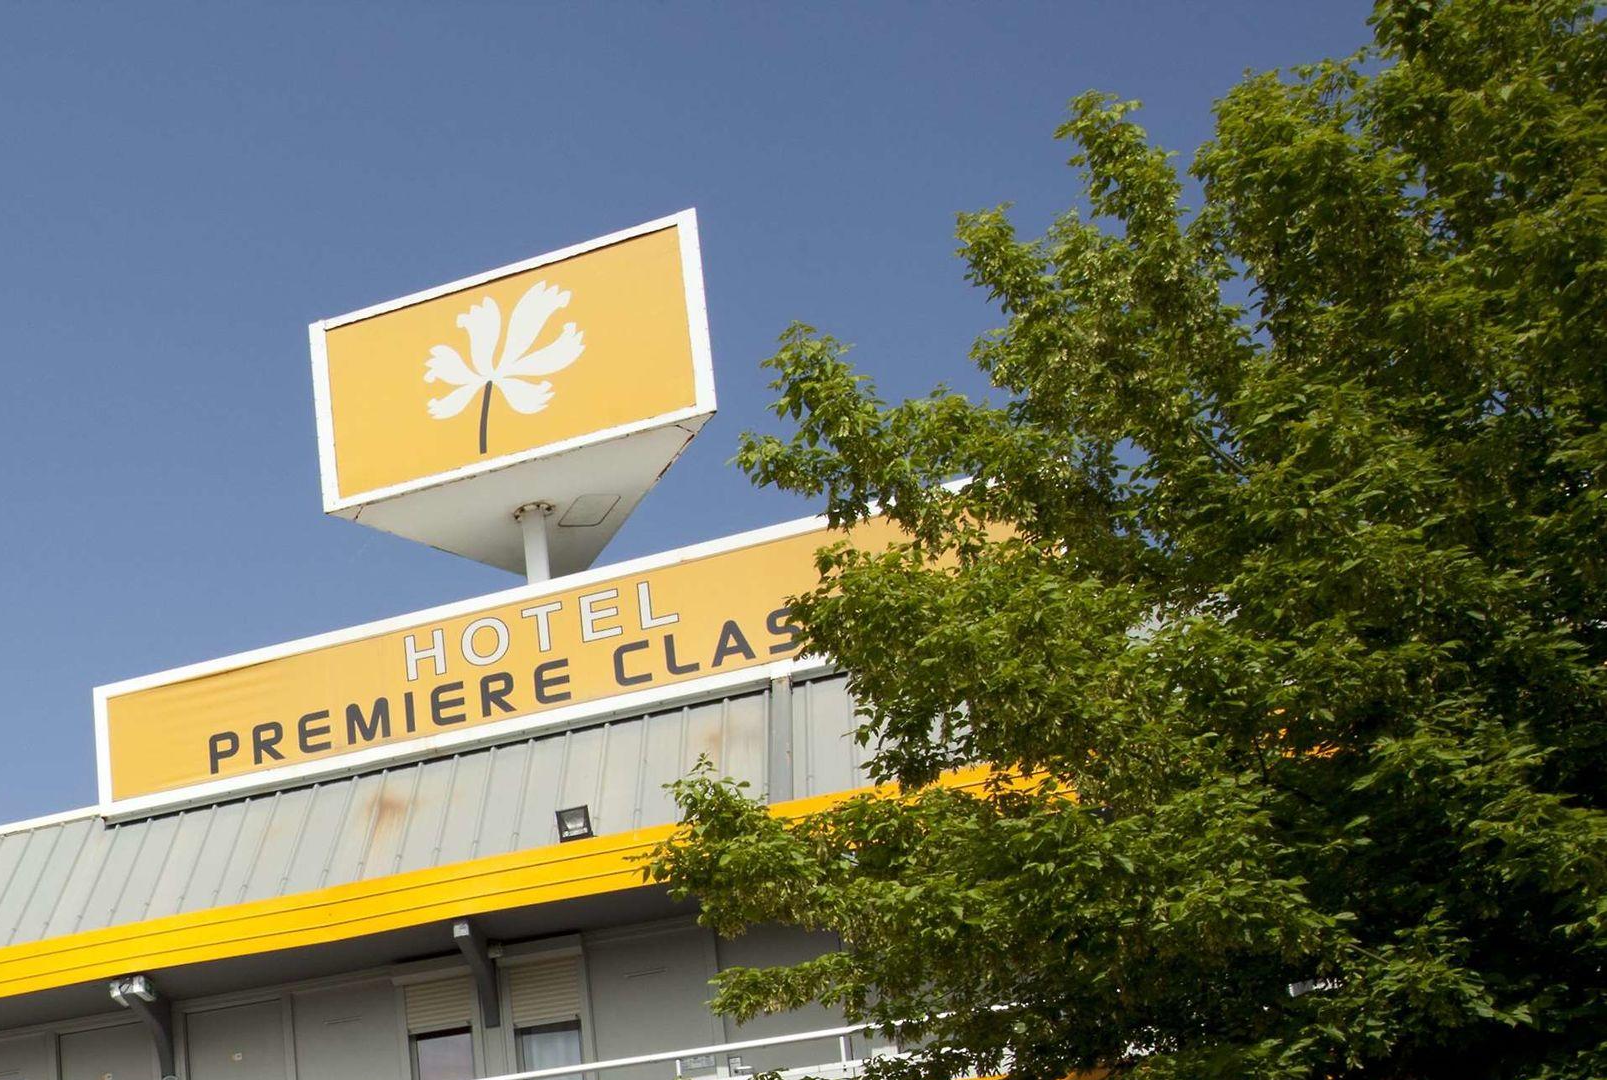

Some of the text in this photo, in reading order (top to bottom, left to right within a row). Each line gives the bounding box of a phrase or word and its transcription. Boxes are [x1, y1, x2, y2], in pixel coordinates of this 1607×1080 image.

[208, 607, 801, 775] PREMIERE CLAS
[403, 580, 680, 682] HOTEL
